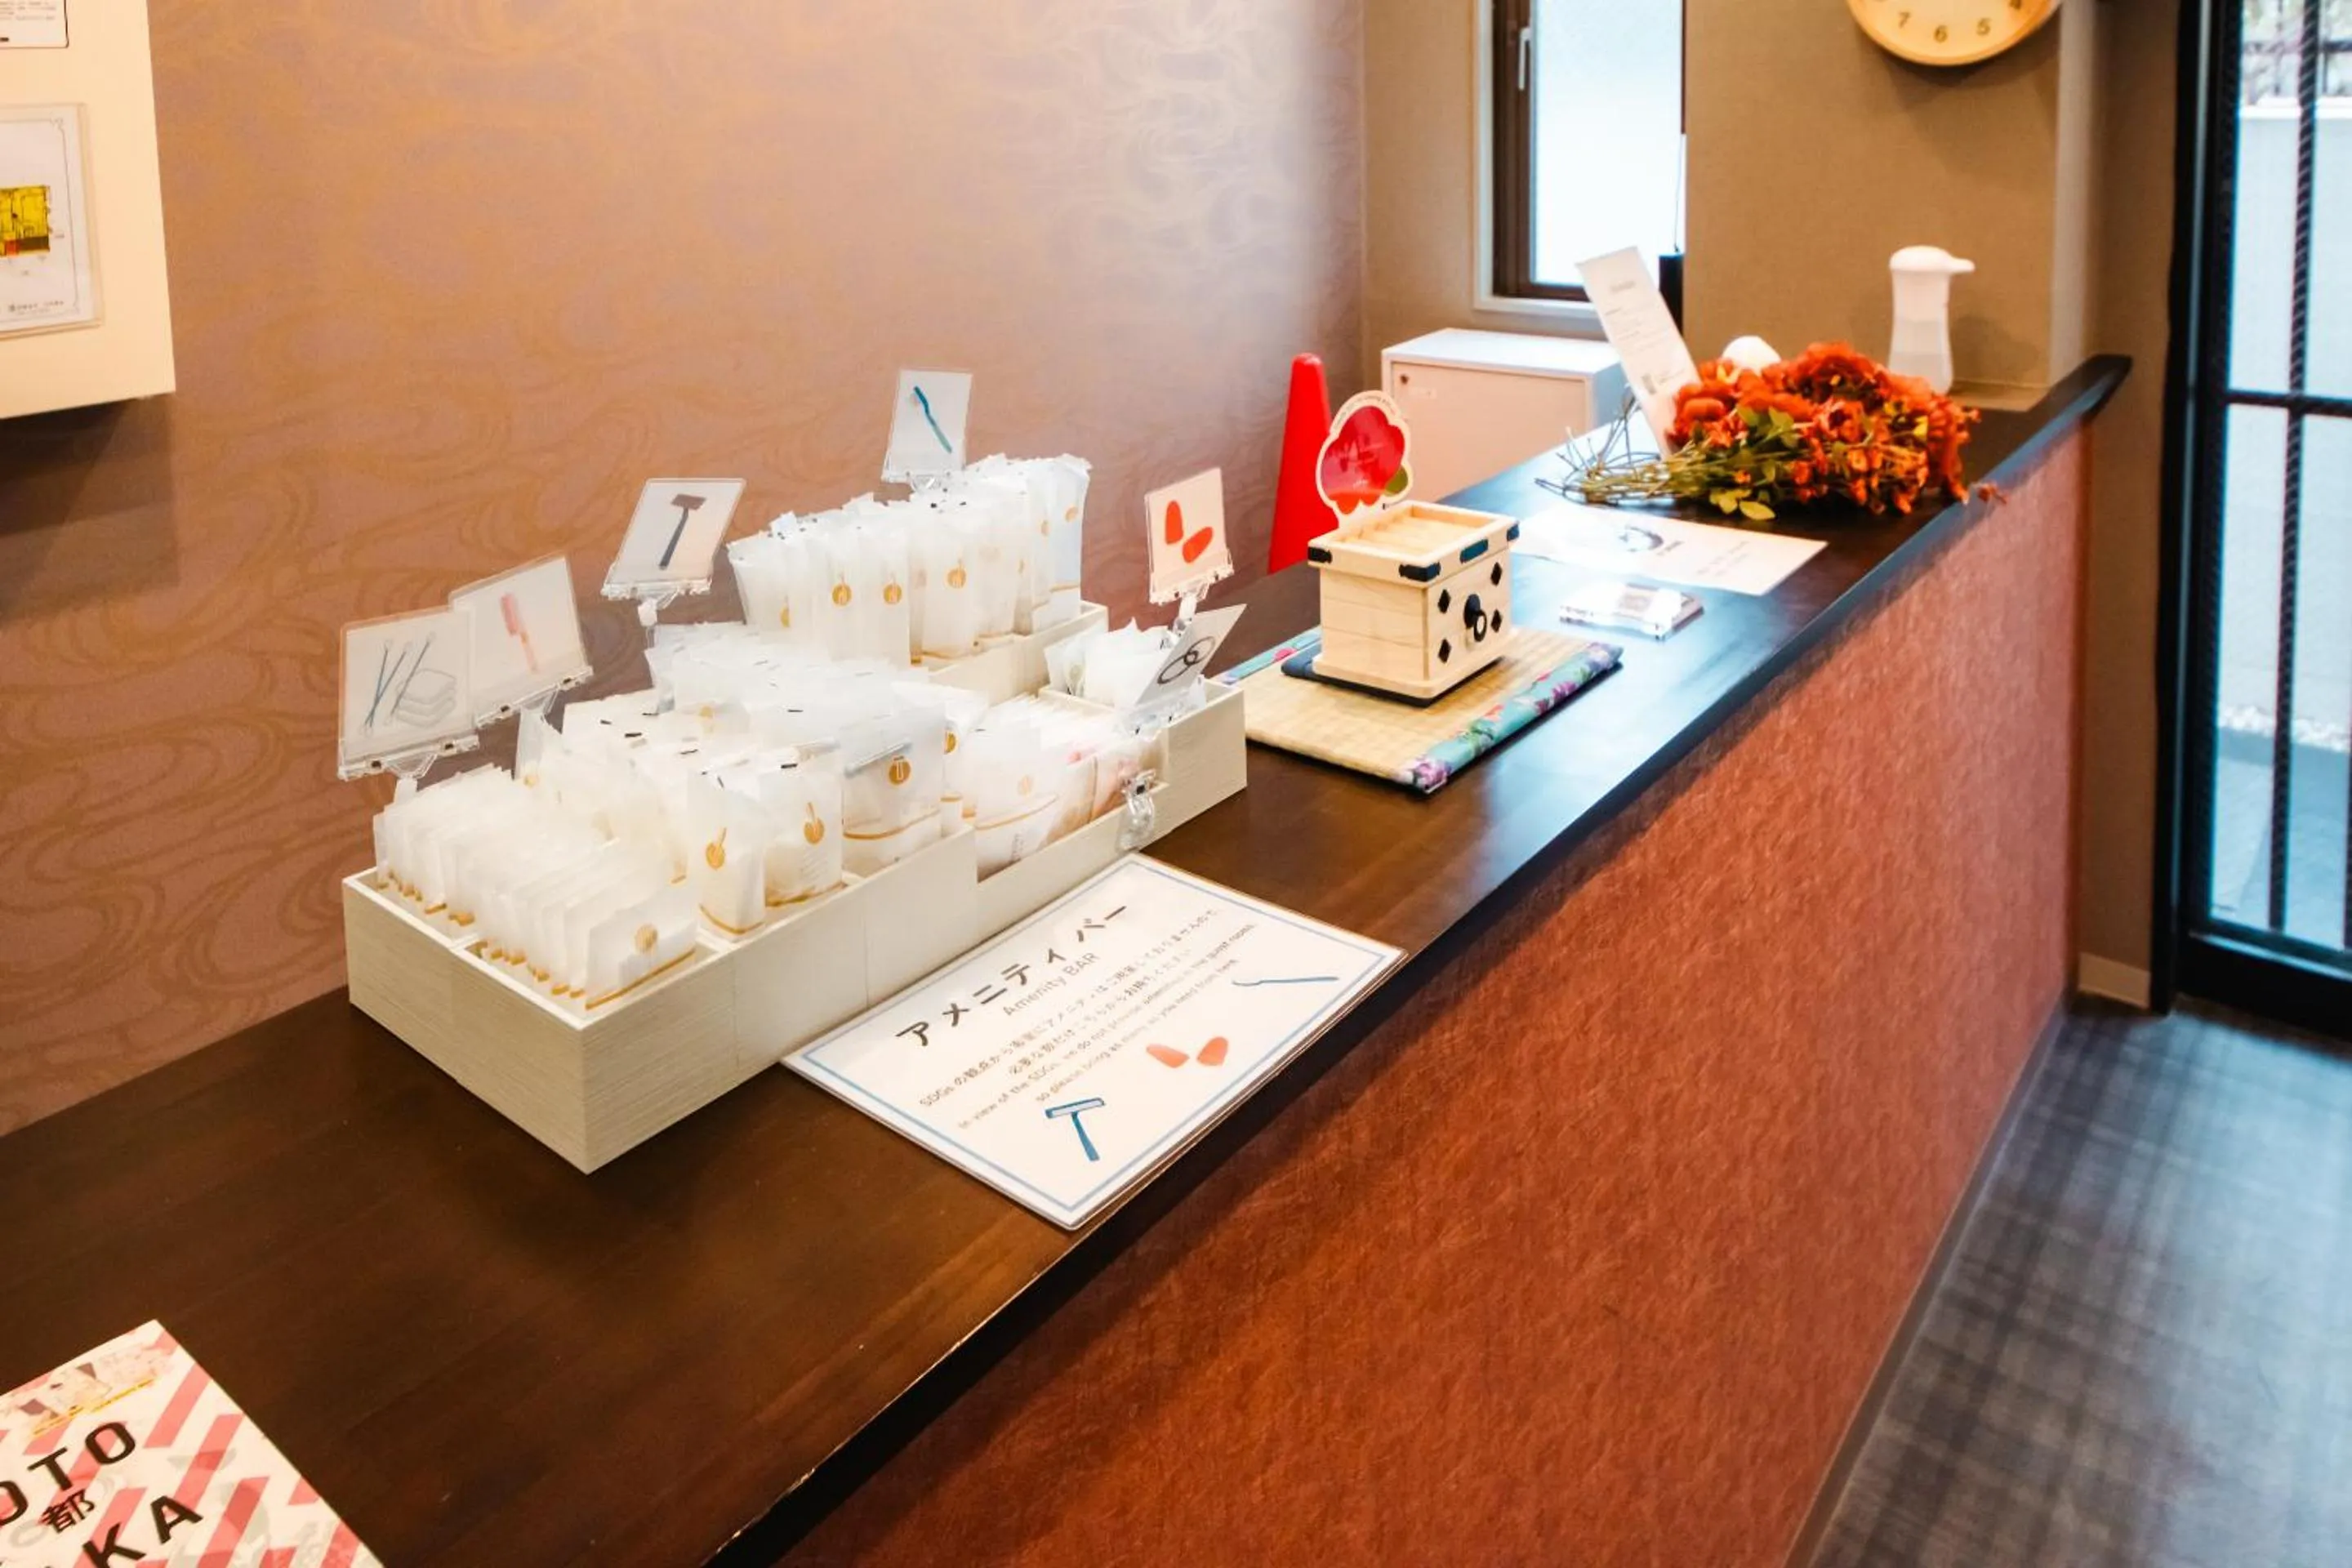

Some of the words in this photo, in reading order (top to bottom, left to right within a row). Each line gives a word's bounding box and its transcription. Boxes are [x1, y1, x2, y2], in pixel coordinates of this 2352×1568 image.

[1899, 11, 1910, 29] 7
[1933, 25, 1949, 43] 6
[1976, 18, 1991, 35] 5
[895, 905, 1128, 1048] アメニティバー
[1002, 975, 1067, 1017] Amenity
[1061, 952, 1101, 977] BAR
[38, 1489, 96, 1534] 都
[43, 1495, 204, 1568] KA
